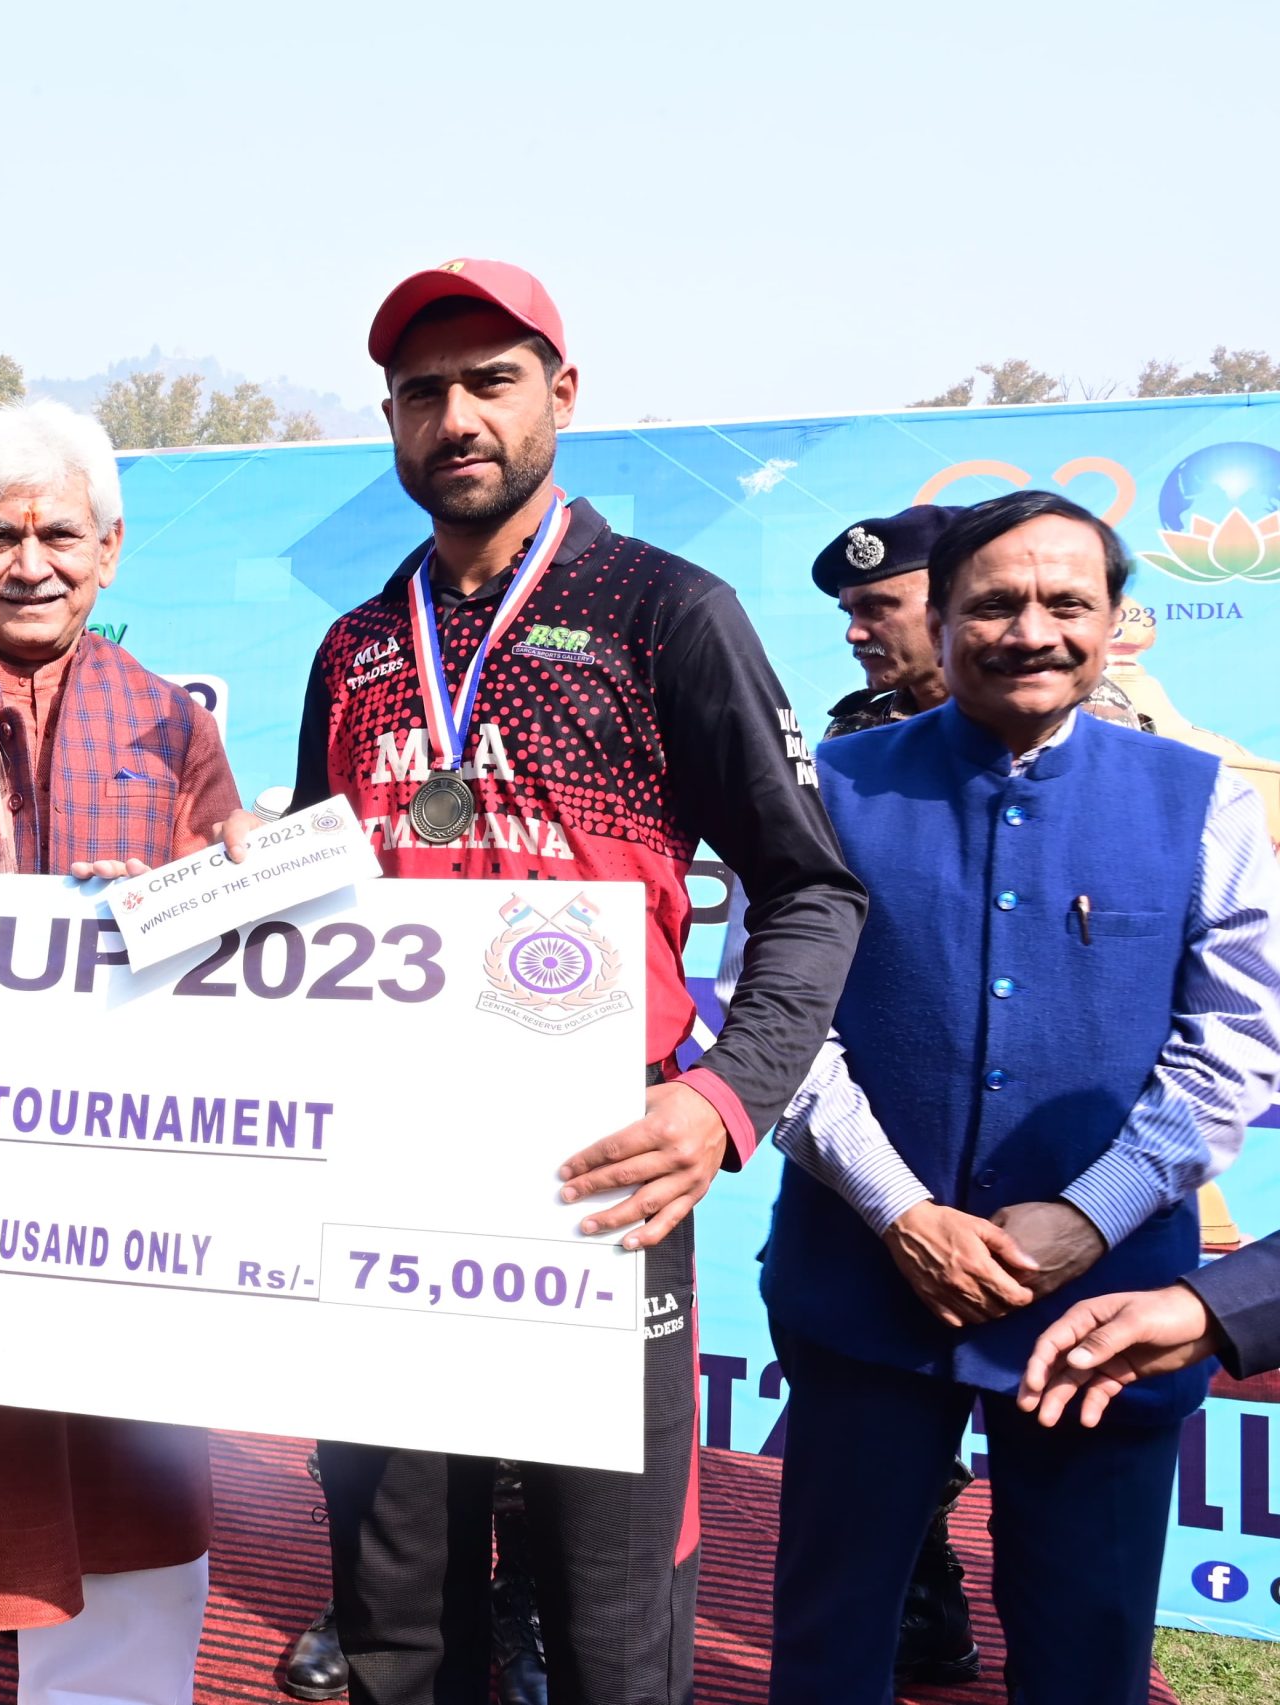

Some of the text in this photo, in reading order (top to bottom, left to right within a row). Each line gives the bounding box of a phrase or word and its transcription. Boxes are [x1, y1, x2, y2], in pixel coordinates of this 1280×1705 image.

[1166, 602, 1244, 620] INDIA
[352, 636, 400, 668] MLA
[562, 653, 591, 662] GALLERY
[346, 657, 405, 690] TRADERS
[371, 723, 514, 785] MA
[148, 823, 306, 893] CRPF 2023
[140, 898, 198, 935] WINNERS
[201, 889, 220, 904] OF
[222, 876, 250, 895] THE
[252, 844, 349, 884] TOURNAMENT
[172, 920, 447, 1004] 2023
[482, 1000, 625, 1031] CENTRAL RESERVE POLICE FORCE
[124, 1228, 212, 1275] ONLY
[237, 1260, 316, 1290] Rs/-
[348, 1250, 613, 1309] 75,000/-
[644, 1316, 684, 1340] ADERS
